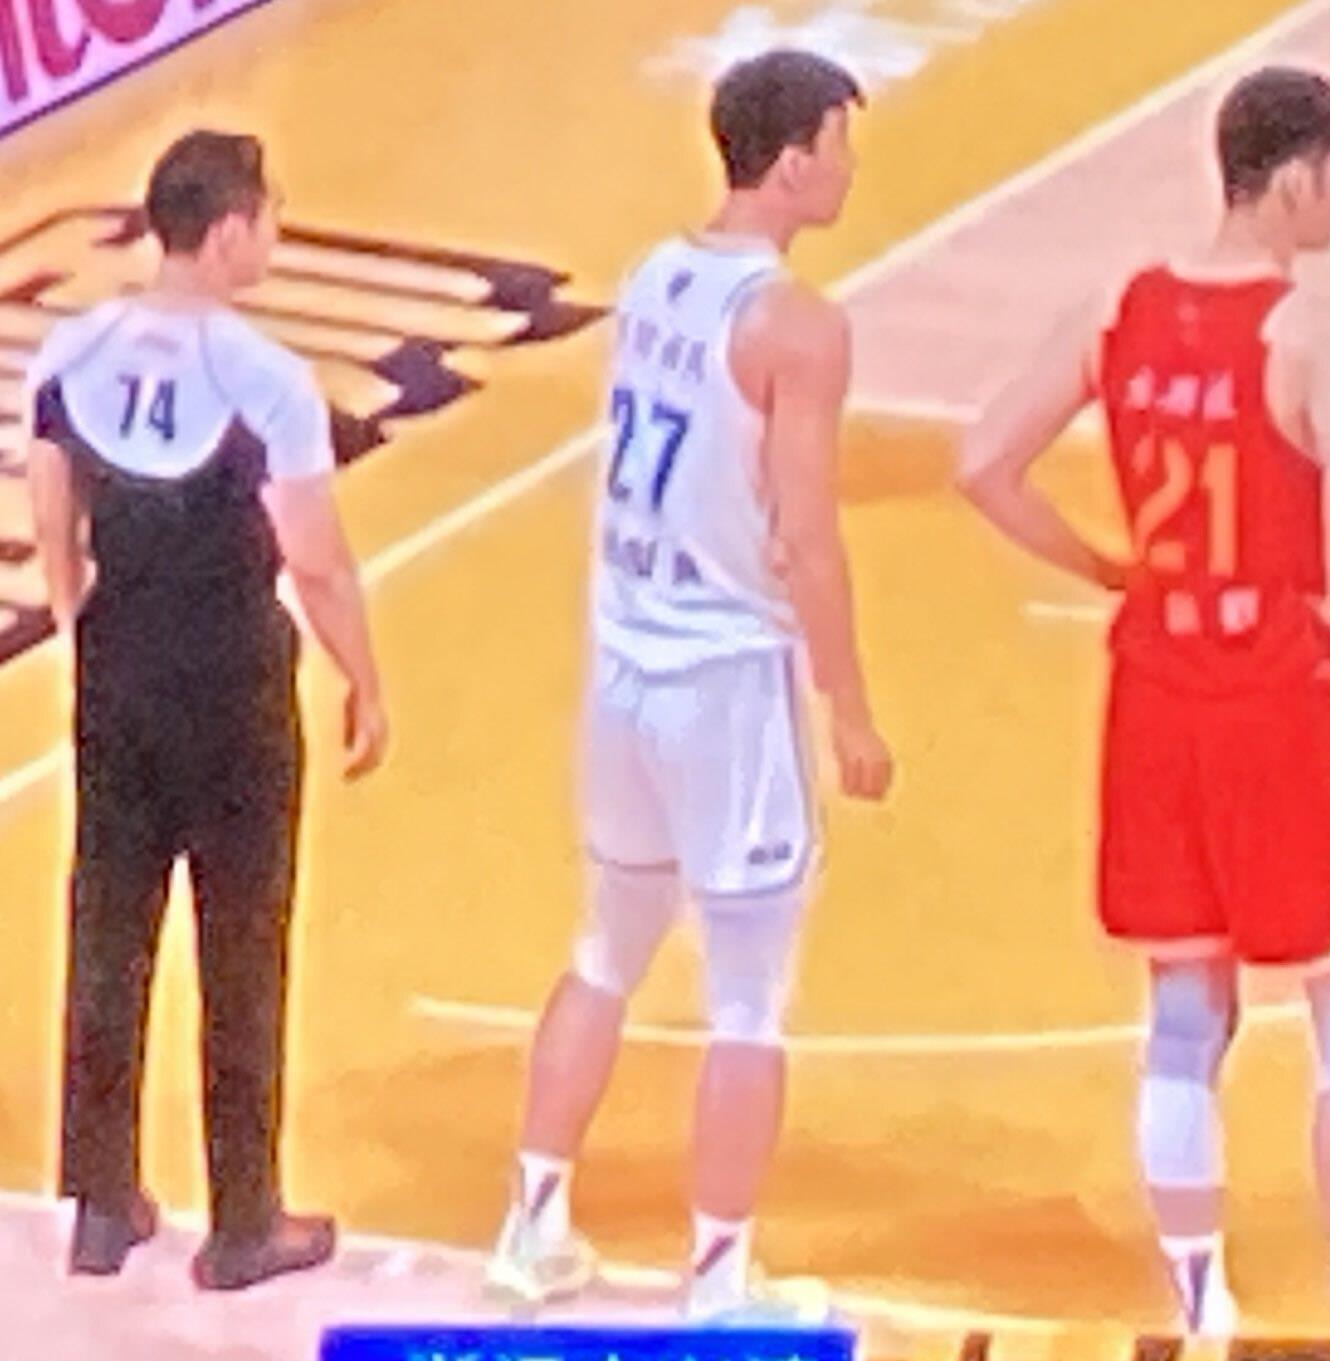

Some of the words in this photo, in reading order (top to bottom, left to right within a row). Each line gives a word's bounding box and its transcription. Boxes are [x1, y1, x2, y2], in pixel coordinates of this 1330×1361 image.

[116, 373, 179, 443] 74
[608, 388, 690, 512] 27
[1133, 437, 1239, 578] 21
